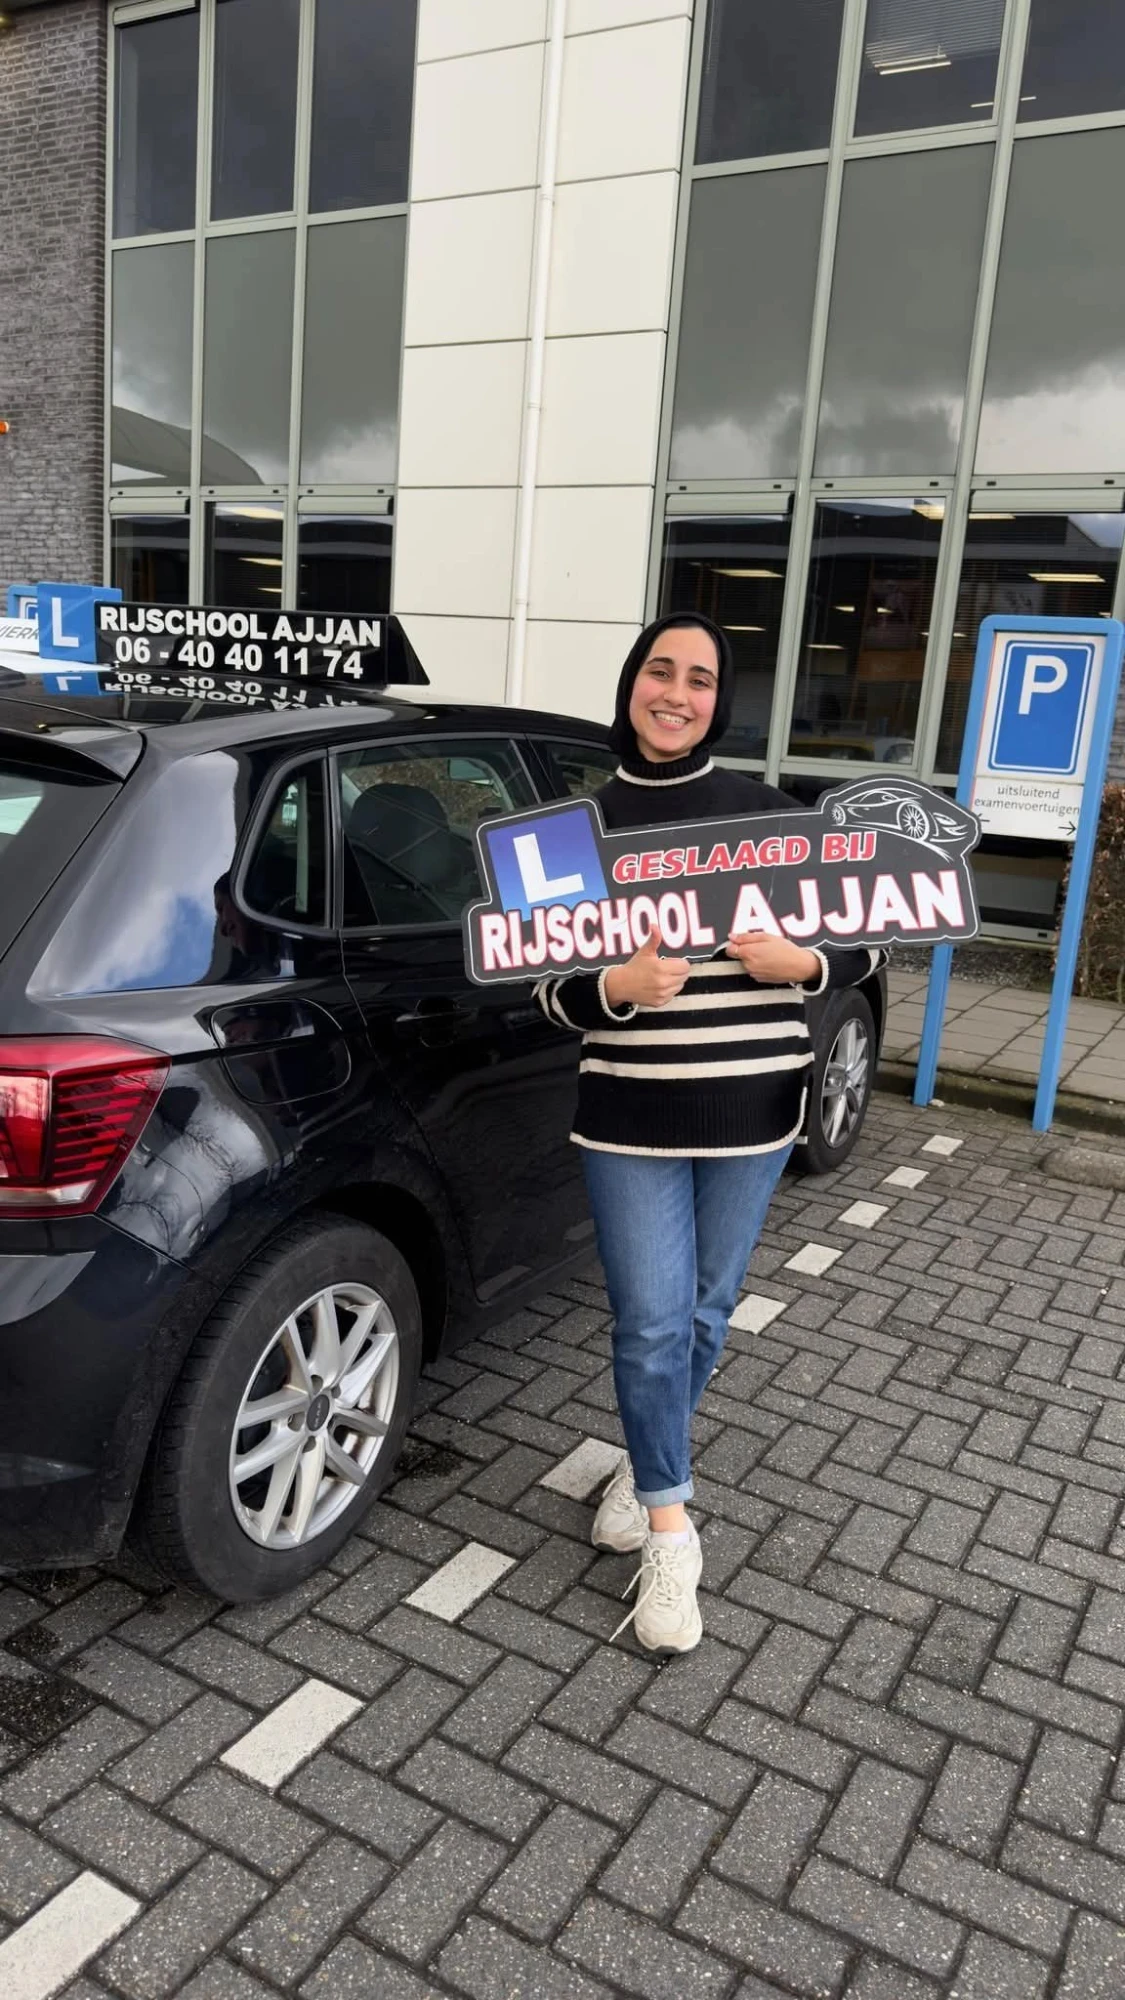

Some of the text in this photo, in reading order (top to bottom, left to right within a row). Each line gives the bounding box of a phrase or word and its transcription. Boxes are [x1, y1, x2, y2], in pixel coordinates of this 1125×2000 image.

[51, 596, 80, 648] L
[100, 606, 381, 648] RIJSCHOOL AJJAN
[115, 636, 151, 664] 06
[177, 640, 215, 669] 40
[224, 642, 263, 672] 40
[274, 646, 309, 676] 11
[322, 649, 364, 680] 74
[1018, 655, 1069, 715] P
[974, 797, 1080, 817] examenvoertuigen
[997, 784, 1061, 800] uitsluitend
[512, 833, 585, 904] L
[612, 831, 877, 884] GESLAAGD BIJ
[479, 870, 966, 971] RIJSCHOOL AJJAN
